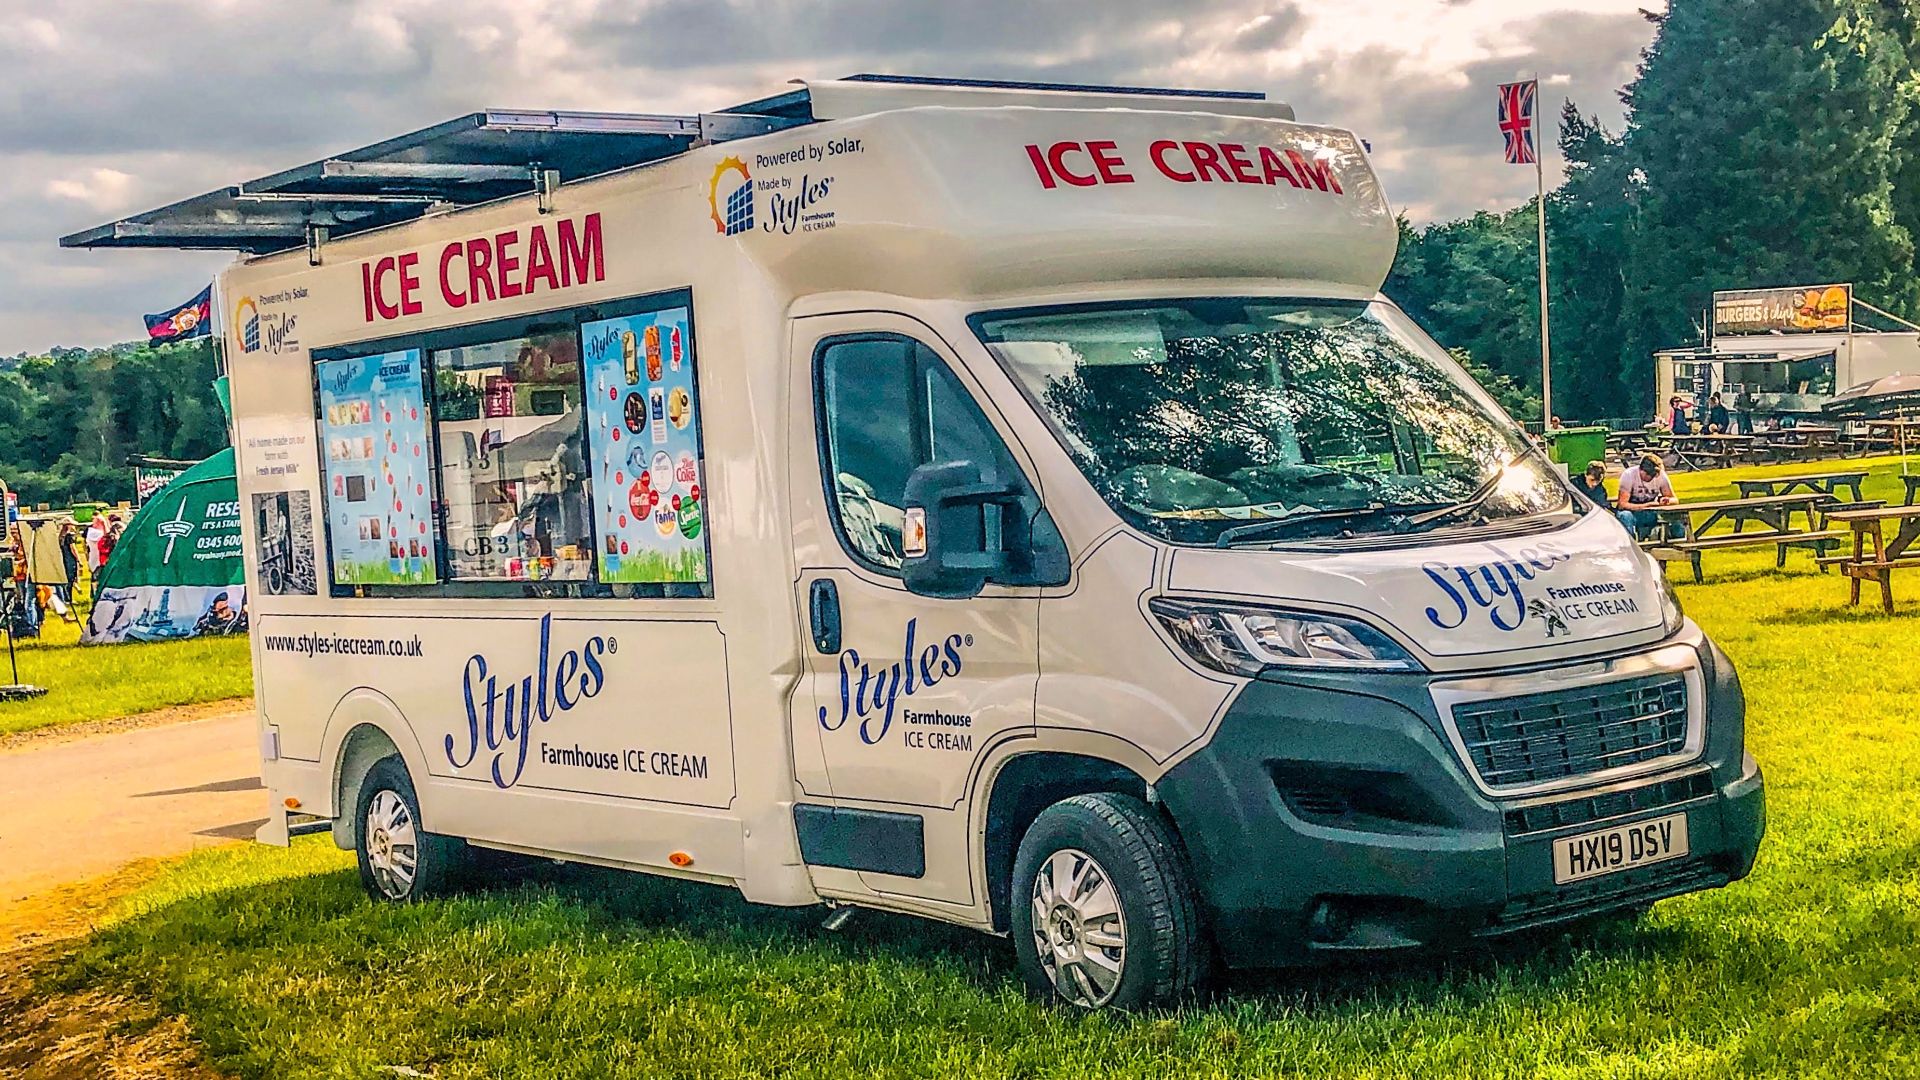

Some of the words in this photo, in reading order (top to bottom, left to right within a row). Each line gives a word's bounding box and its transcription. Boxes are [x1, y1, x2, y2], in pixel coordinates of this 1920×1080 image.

[757, 145, 805, 168] Powered
[809, 144, 824, 162] by
[828, 137, 864, 156] Solar,
[1025, 140, 1135, 189] ICE
[1149, 140, 1343, 195] CREAM
[758, 178, 780, 191] Made
[781, 176, 792, 189] by
[802, 211, 835, 222] Farmhouse
[803, 223, 812, 233] ICE
[813, 220, 836, 231] CREAM
[361, 252, 423, 323] ICE
[439, 212, 606, 308] CREAM
[1716, 306, 1762, 324] BURGERS
[379, 366, 389, 377] ICE
[389, 363, 411, 376] CREAM
[676, 467, 696, 482] Coke
[655, 508, 676, 525] Fanta
[197, 536, 222, 549] 0345
[1421, 540, 1571, 631] Styles
[1546, 580, 1626, 600] Farmhouse
[1559, 602, 1586, 621] ICE
[1587, 598, 1639, 619] CREAM
[265, 631, 423, 658] www.styles-icecream.co.uk
[904, 709, 972, 728] Farmhouse
[904, 731, 924, 749] ICE
[928, 732, 973, 752] CREAM
[541, 741, 619, 771] Farmhouse
[623, 748, 646, 774] ICE
[651, 752, 709, 779] CREAM
[1569, 833, 1623, 875] HX19
[1629, 820, 1672, 862] DSV
